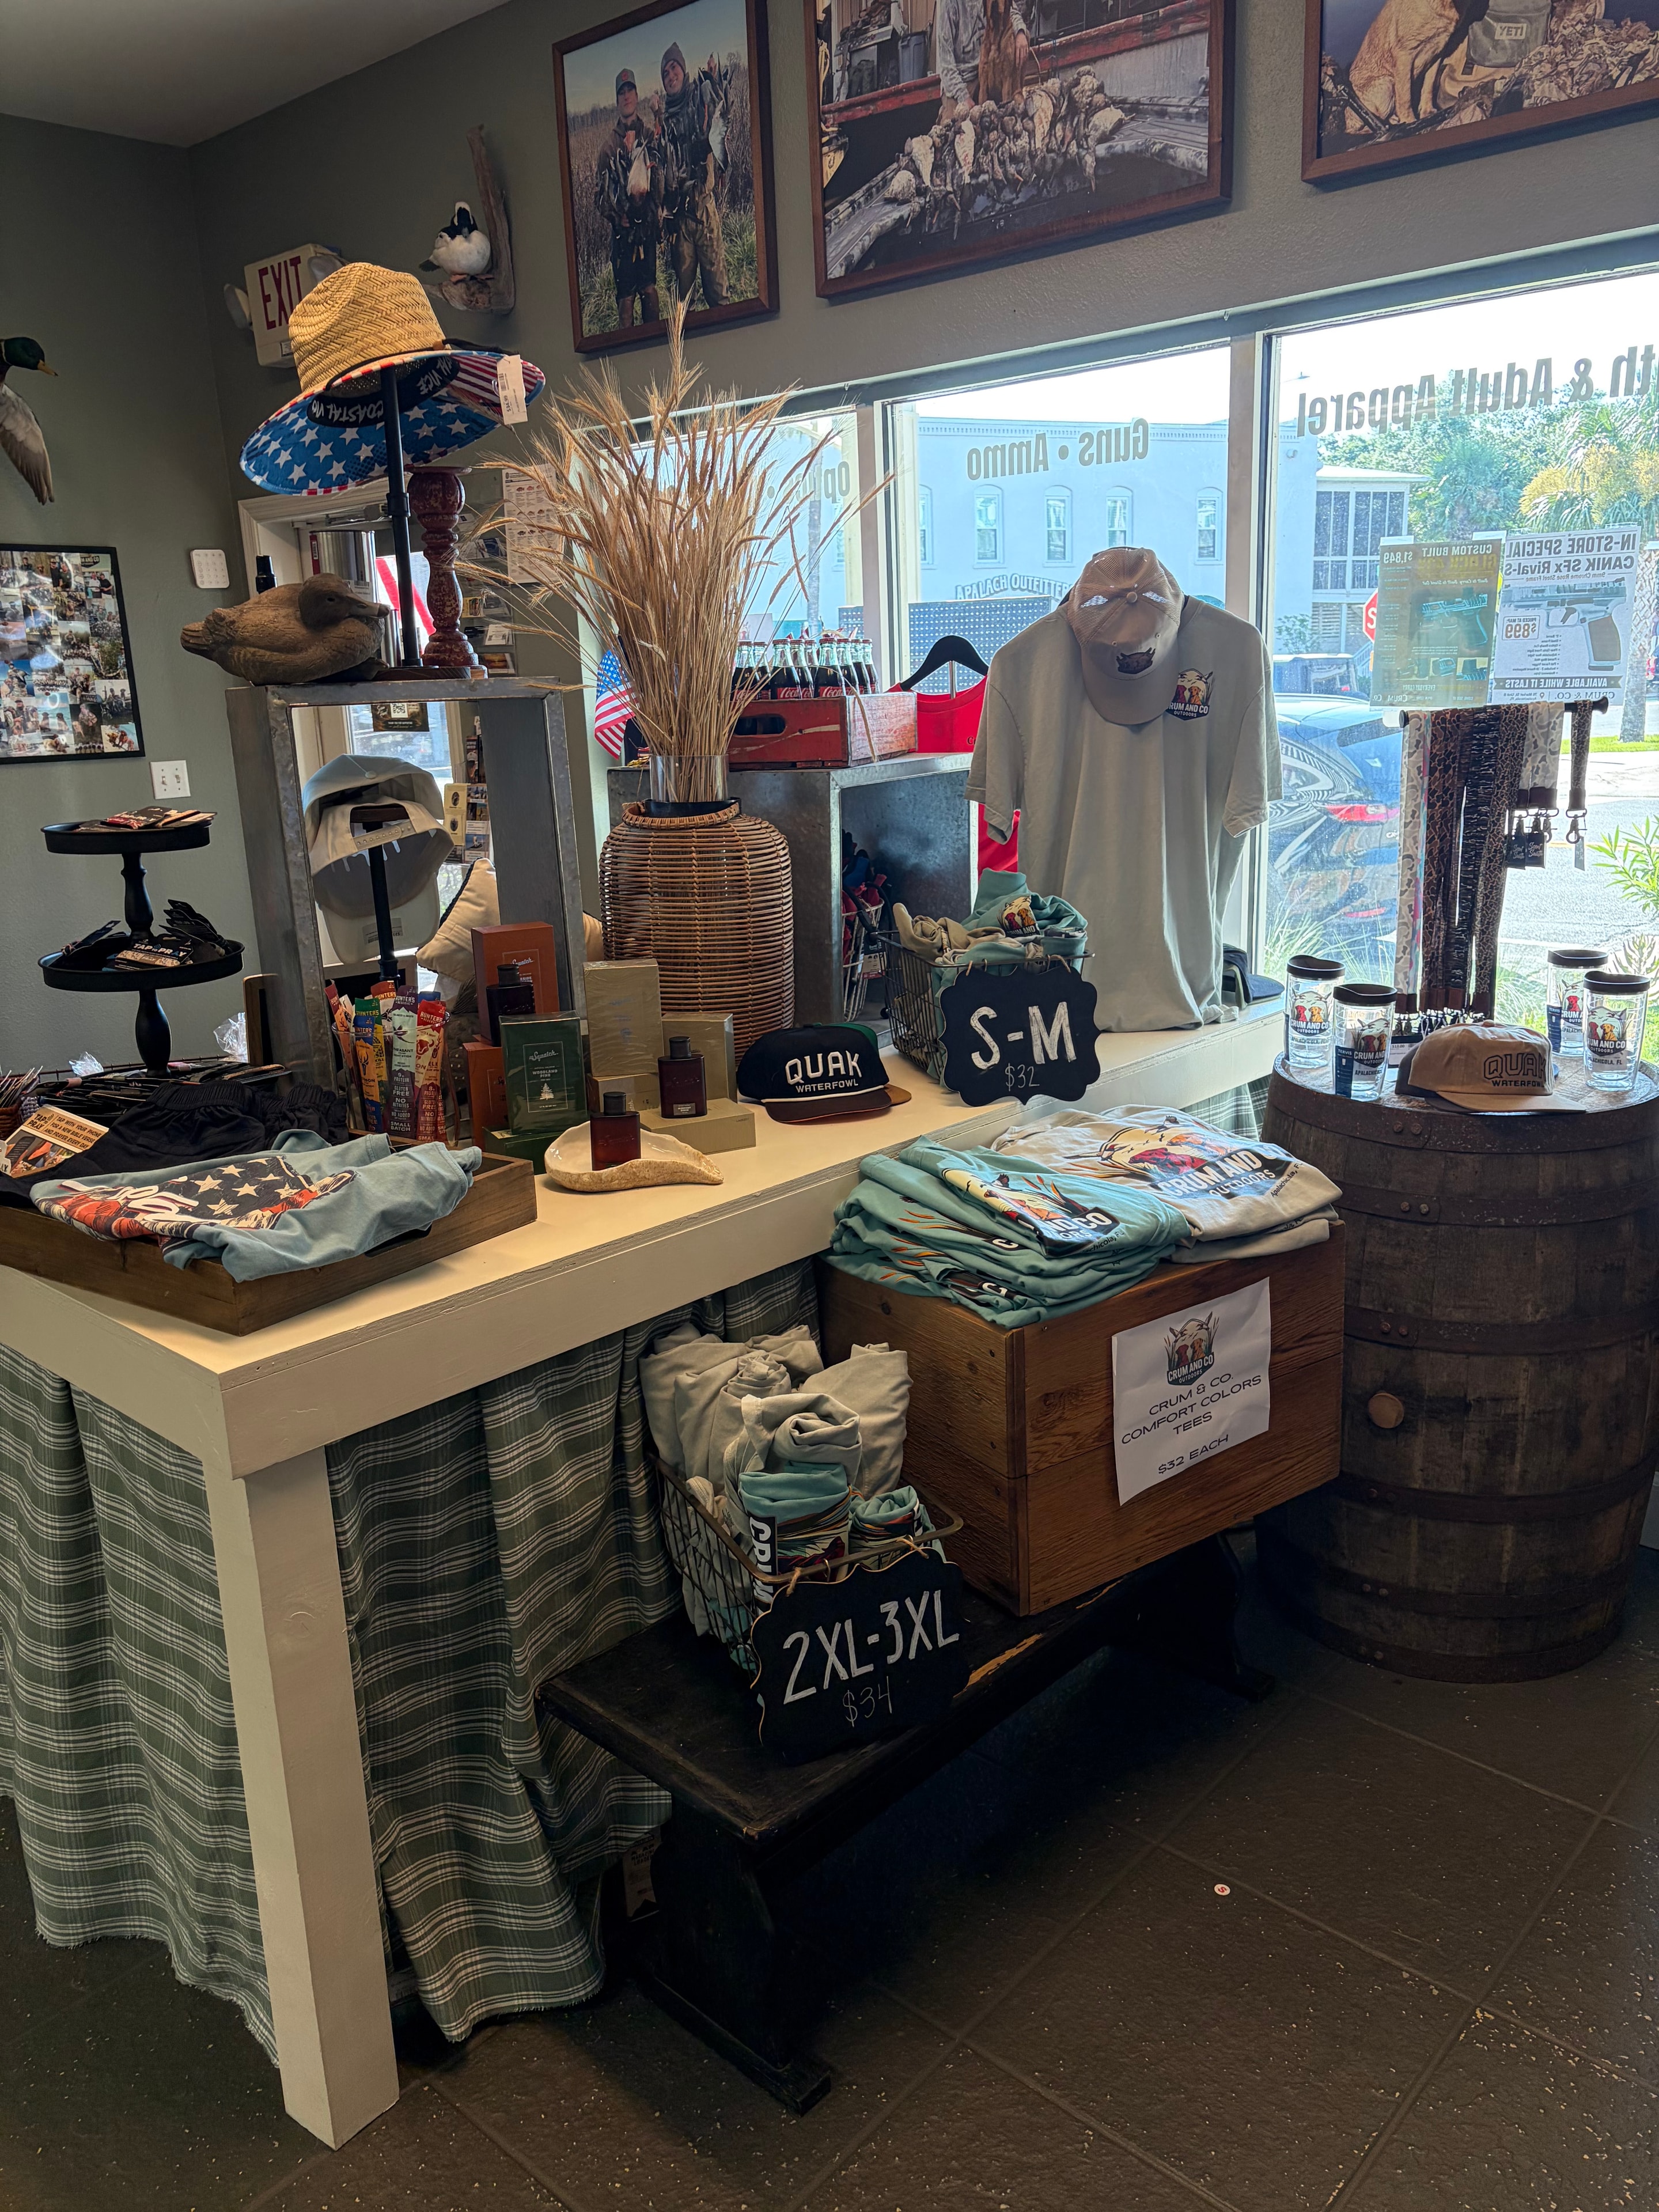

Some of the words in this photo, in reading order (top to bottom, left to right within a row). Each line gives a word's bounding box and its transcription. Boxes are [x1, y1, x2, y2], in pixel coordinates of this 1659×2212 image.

[1499, 25, 1524, 36] YETI
[258, 255, 305, 330] EXIT
[327, 399, 384, 424] COASTAL
[955, 574, 1007, 600] APALACH
[1168, 702, 1184, 711] RUM
[1185, 703, 1199, 713] AND
[1199, 705, 1209, 714] CO
[157, 947, 187, 957] PRAY
[1290, 1019, 1306, 1029] CRUM
[1306, 1021, 1321, 1029] AND
[970, 1001, 1077, 1070] S-M
[1599, 1040, 1615, 1048] AND
[1615, 1040, 1626, 1048] CO
[532, 1049, 559, 1062] Squatch
[1354, 1051, 1374, 1060] CRUM
[1483, 1052, 1547, 1080] QUAK
[785, 1050, 862, 1085] QUAK
[1005, 1062, 1040, 1092] $32
[795, 1078, 859, 1093] WATERFOWL
[1491, 1079, 1546, 1088] WATERFOWL
[27, 1120, 45, 1130] PRAY
[34, 1113, 47, 1123] TAP
[64, 1119, 75, 1127] WITH
[76, 1124, 88, 1132] YOUR
[87, 1129, 102, 1138] PHONE
[52, 1131, 68, 1141] PRAYER
[67, 1136, 81, 1146] EVERY
[70, 1130, 82, 1138] BIBLE
[82, 1135, 96, 1144] VERSE
[1157, 1165, 1226, 1196] CRUM
[1215, 1150, 1262, 1178] AND
[1209, 1169, 1276, 1197] OUTDOORS
[1039, 1219, 1076, 1232] ND
[1077, 1212, 1113, 1229] CO
[1168, 1365, 1188, 1382] CRUM
[1188, 1358, 1203, 1373] AND
[1203, 1354, 1213, 1367] CO
[1178, 1369, 1203, 1384] OUTDOORS
[1149, 1389, 1192, 1415] CRUM
[1196, 1384, 1206, 1395] &
[1210, 1373, 1233, 1388] CO.
[1121, 1403, 1197, 1444] COMFORT
[1200, 1374, 1262, 1407] COLORS
[1172, 1411, 1213, 1435] TEES
[1158, 1456, 1184, 1474] $32
[1189, 1434, 1229, 1460] EACH
[782, 1589, 960, 1705] 2XL-3XL
[842, 1675, 893, 1728] $34
